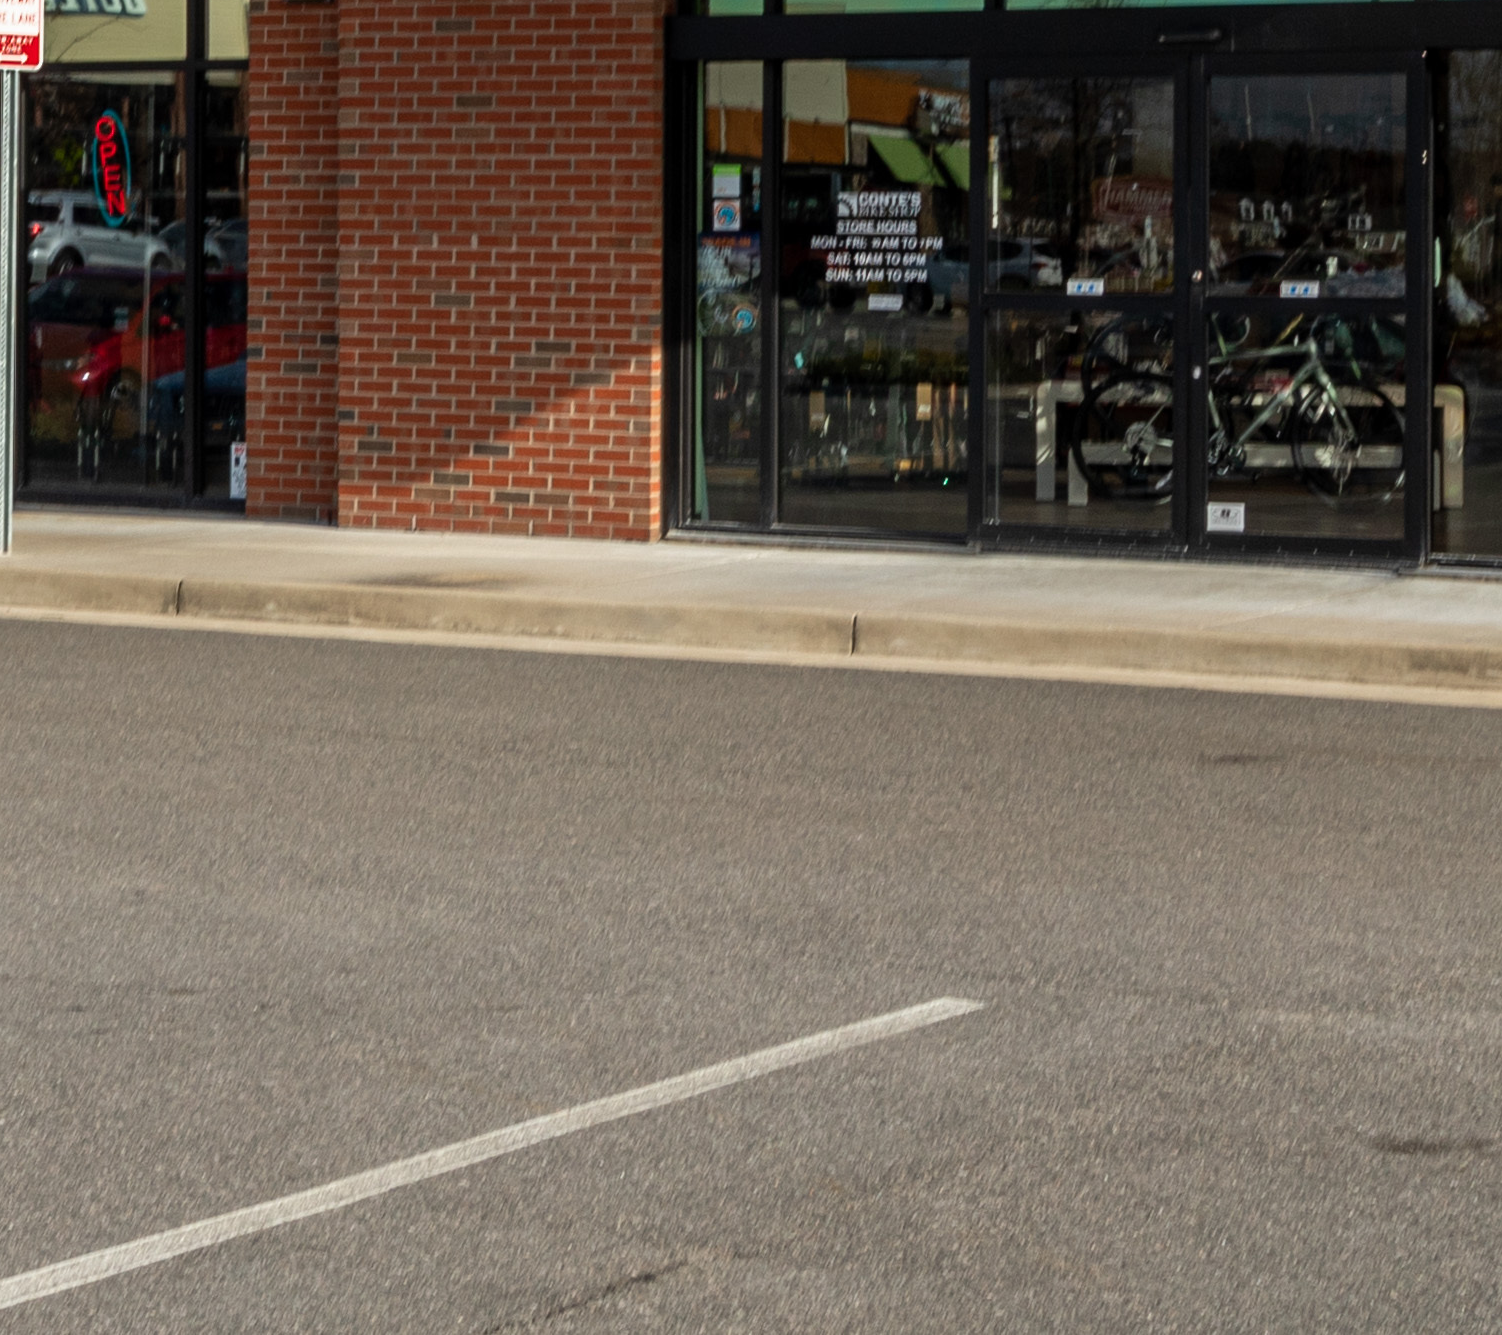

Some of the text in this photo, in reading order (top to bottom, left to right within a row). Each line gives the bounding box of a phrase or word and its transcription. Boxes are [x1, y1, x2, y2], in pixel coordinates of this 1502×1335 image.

[11, 12, 37, 25] LANE
[95, 115, 126, 217] OPEN
[858, 191, 922, 207] CONTE'S
[836, 219, 918, 234] STORE HOURS
[810, 235, 838, 250] MON
[901, 235, 918, 250] TO
[853, 252, 884, 266] 10AM
[885, 252, 901, 266] TO
[855, 268, 885, 282] 11AM
[886, 268, 902, 282] TO
[903, 268, 929, 283] 5PM
